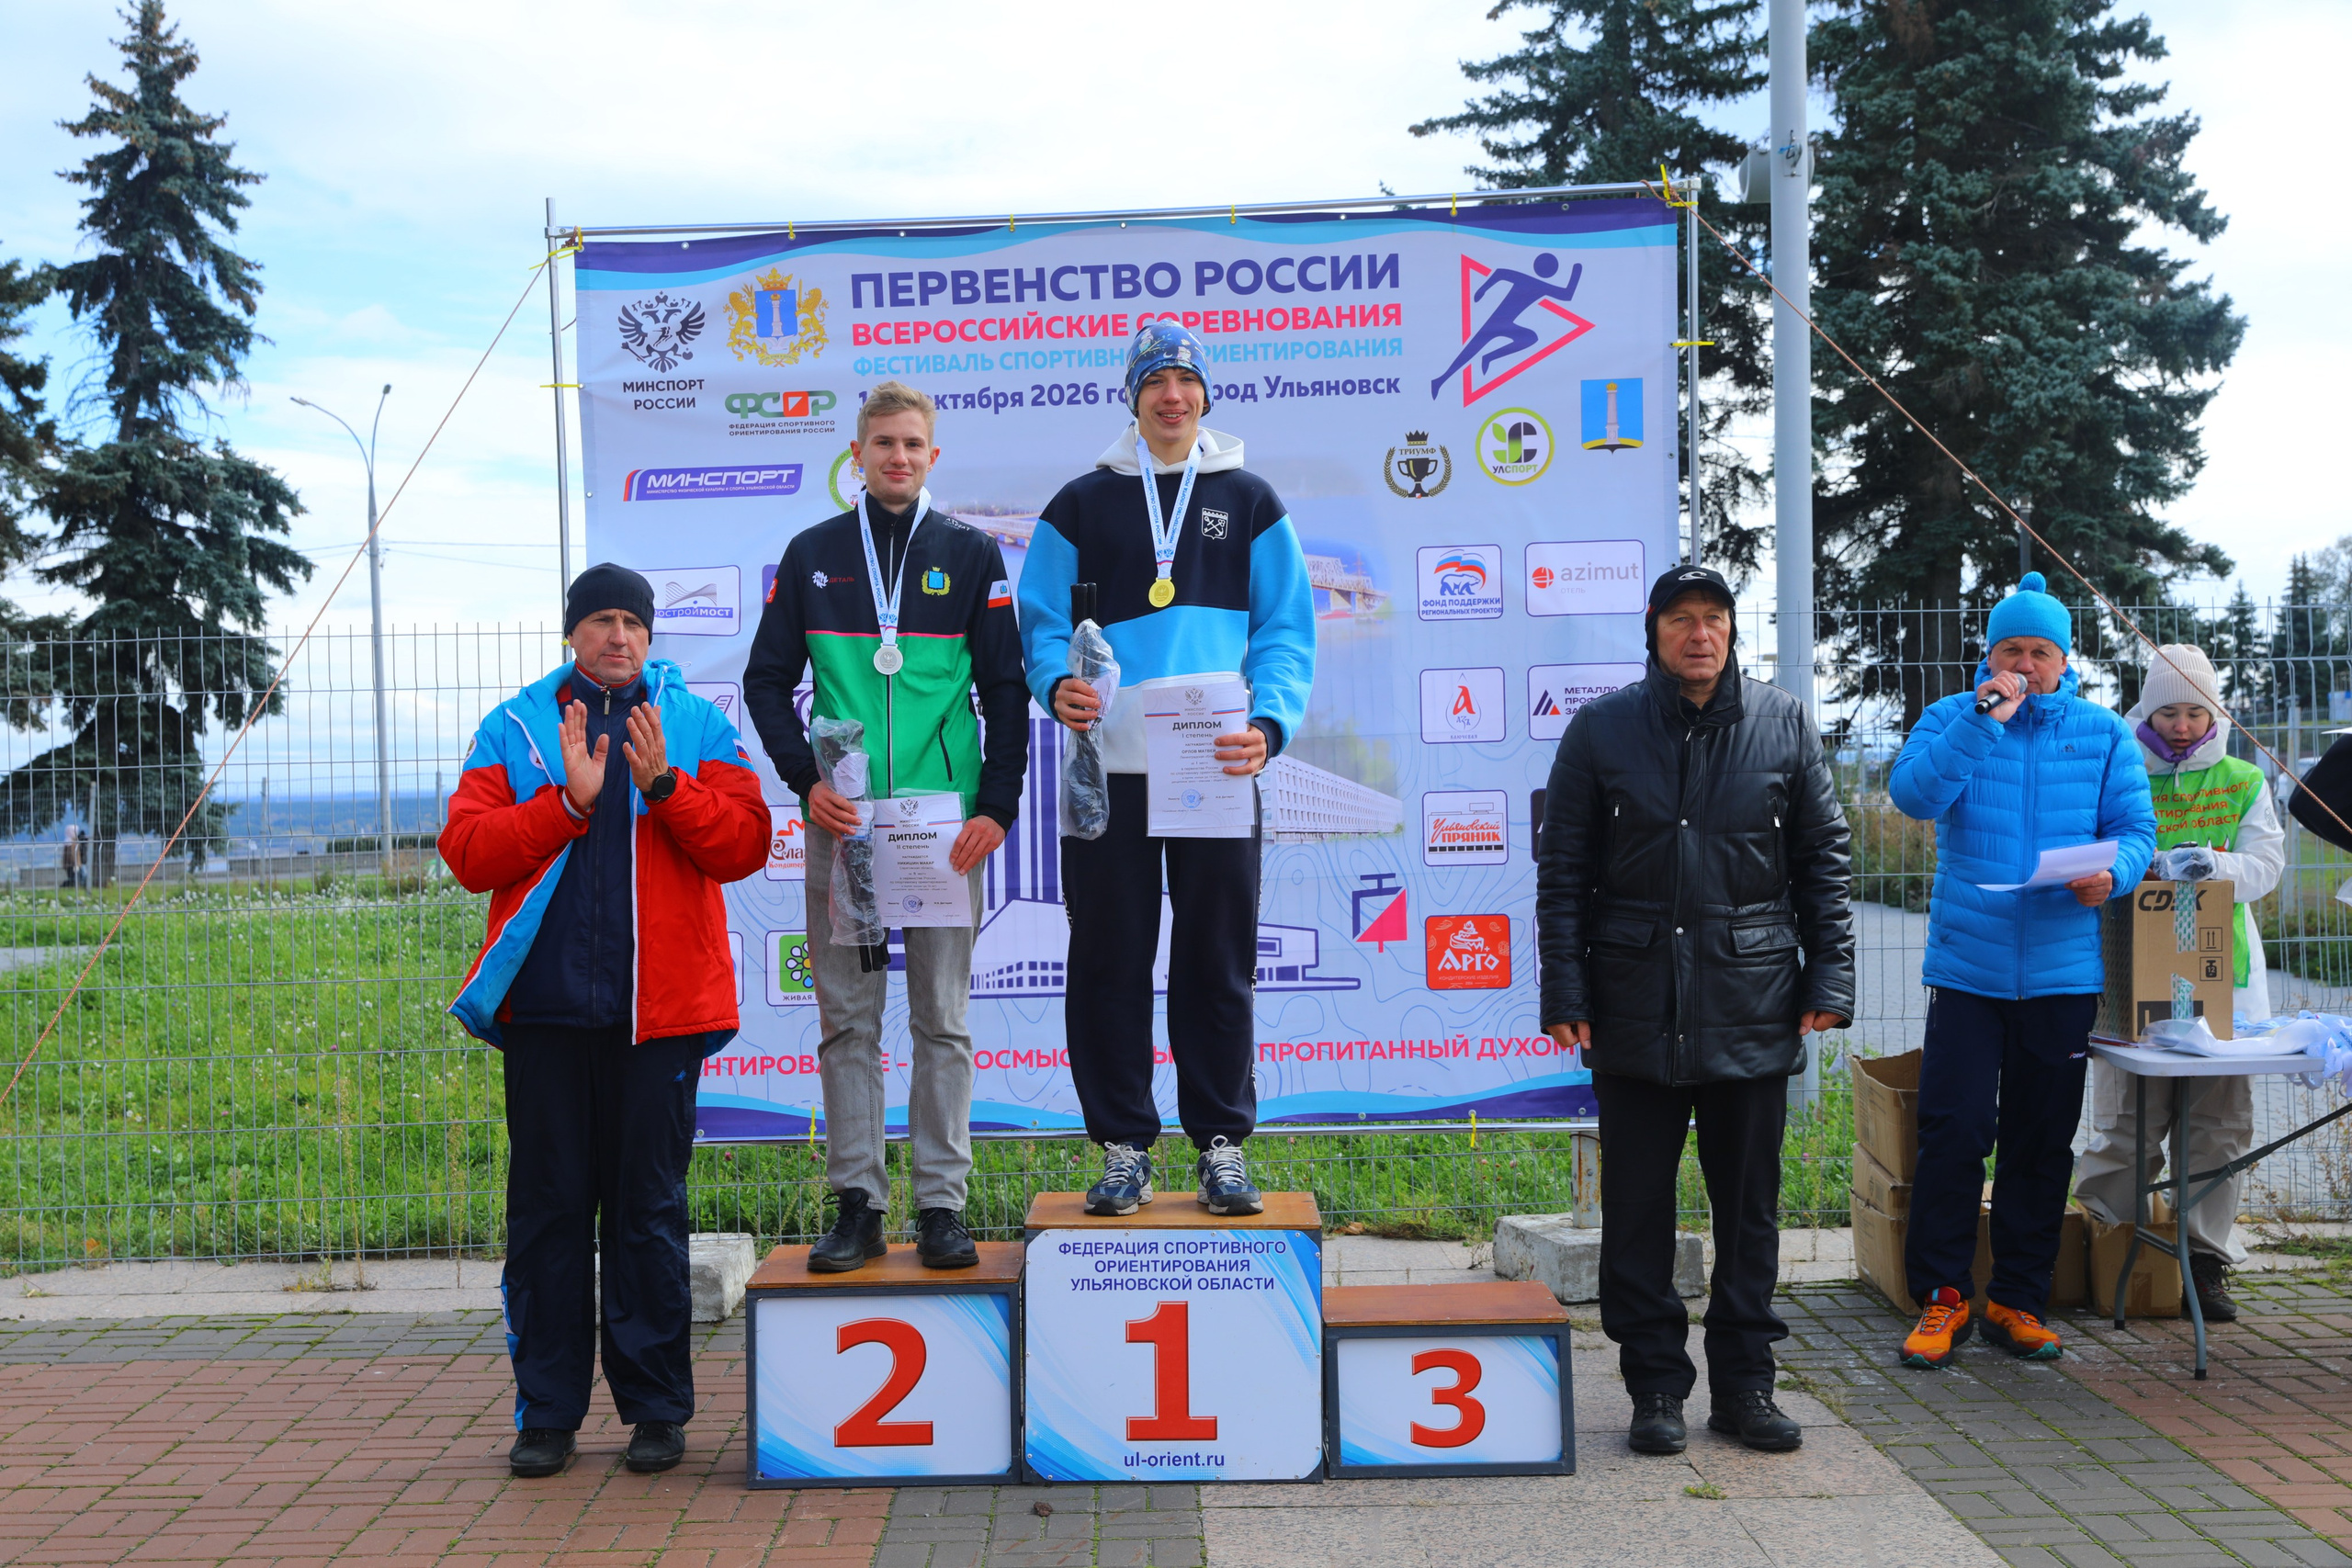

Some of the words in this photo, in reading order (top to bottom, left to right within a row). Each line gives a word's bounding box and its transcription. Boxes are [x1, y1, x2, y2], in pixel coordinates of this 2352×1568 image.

[851, 262, 1182, 309] ПЕРВЕНСТВО
[1194, 253, 1400, 298] РОССИИ
[853, 310, 1128, 346] ВСЕРОССИЙСКИЕ
[853, 353, 994, 377] ФЕСТИВАЛЬ
[999, 347, 1125, 371] СПОРТИВН
[623, 379, 705, 392] МИНСПОРТ
[932, 386, 1023, 414] ктября
[1031, 382, 1100, 407] 2026
[1263, 375, 1400, 399] Ульяновск
[634, 397, 695, 411] РОССИИ
[1398, 446, 1437, 457] ТРИУМФ
[647, 469, 796, 489] МИНСПОРТ
[1492, 464, 1538, 474] УЛСПОРТ
[1560, 561, 1639, 581] azimut
[1422, 599, 1447, 608] ФОНД
[1448, 597, 1500, 607] ПОДДЕРЖКИ
[1172, 721, 1222, 731] ДИПЛОМ
[888, 831, 937, 842] ДИПЛОМ
[1430, 818, 1500, 843] Ульяновский
[1442, 831, 1501, 843] ПРЯНИК
[2138, 889, 2208, 911] CDK
[1437, 948, 1499, 972] АРГО
[1259, 1033, 1469, 1062] ПРОПИТАННЫЙ
[1058, 1241, 1159, 1258] ФЕДЕРАЦИЯ
[1163, 1239, 1286, 1256] СПОРТИВНОГО
[1094, 1258, 1250, 1274] ОРИЕНТИРОВАНИЯ
[1070, 1275, 1193, 1292] УЛЬЯНОВСКОЙ
[1196, 1277, 1274, 1291] ОБЛАСТИ
[1125, 1301, 1217, 1441] 1
[834, 1317, 933, 1448] 2
[1410, 1348, 1486, 1449] 3
[1124, 1451, 1225, 1468] ul-orient.ru
